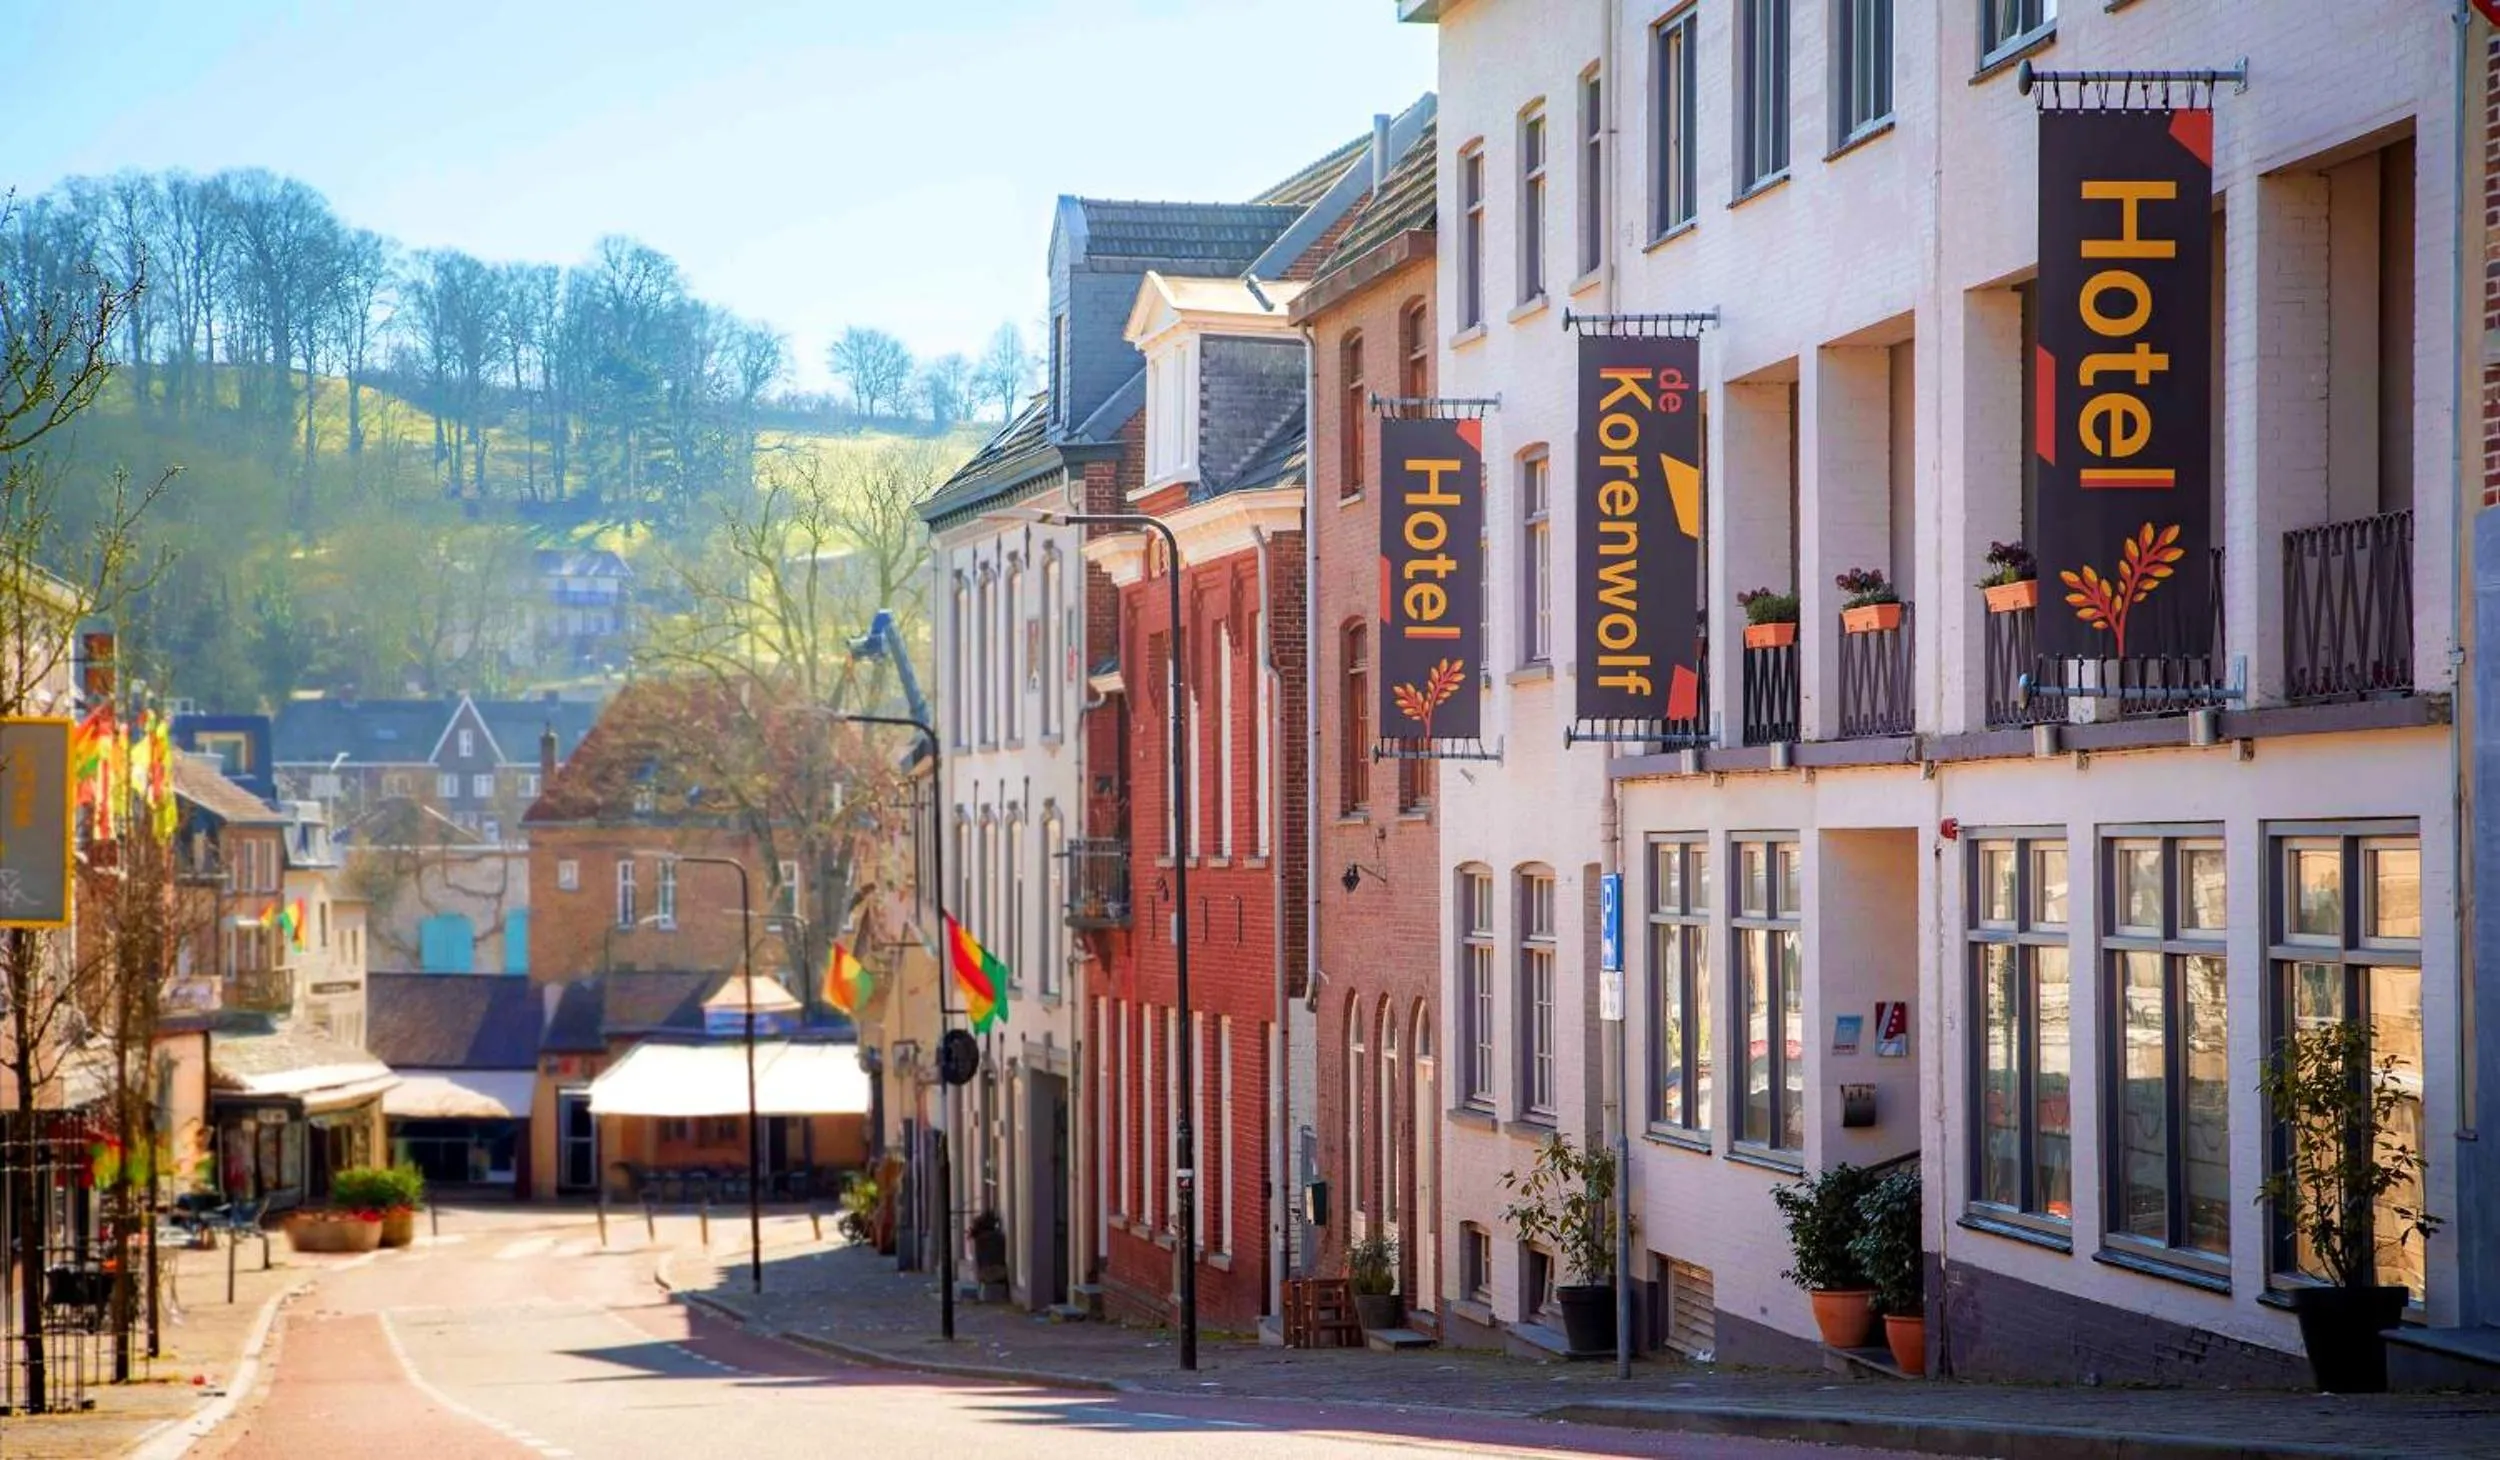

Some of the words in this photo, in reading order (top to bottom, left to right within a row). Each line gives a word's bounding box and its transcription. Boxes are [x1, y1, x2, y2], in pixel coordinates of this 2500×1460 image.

[1659, 368, 1690, 413] de
[2079, 180, 2176, 488] Hotel
[1404, 460, 1461, 639] Hotel
[1598, 367, 1652, 696] Korenwolf
[1603, 883, 1613, 930] P
